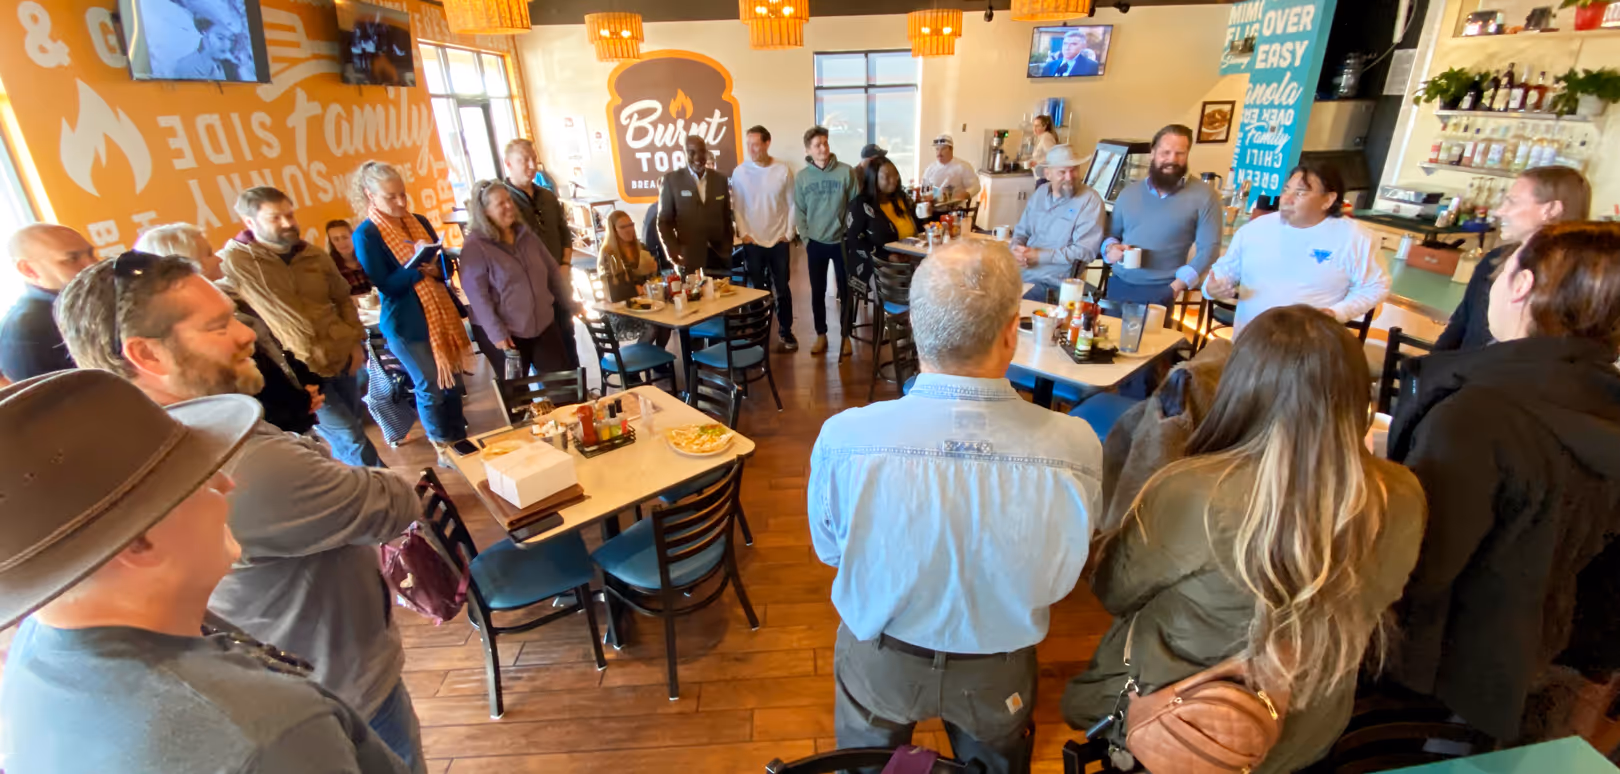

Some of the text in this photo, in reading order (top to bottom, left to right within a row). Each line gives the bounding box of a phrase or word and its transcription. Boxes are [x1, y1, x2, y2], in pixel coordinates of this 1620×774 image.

[17, 1, 71, 68] &
[1262, 4, 1315, 37] OVER
[1255, 40, 1309, 69] EASY
[257, 60, 433, 177] Family
[620, 99, 728, 148] Burnt
[156, 111, 281, 170] SIDE
[1245, 121, 1290, 153] Family
[635, 150, 721, 172] TOAT
[1246, 149, 1283, 168] CHILI
